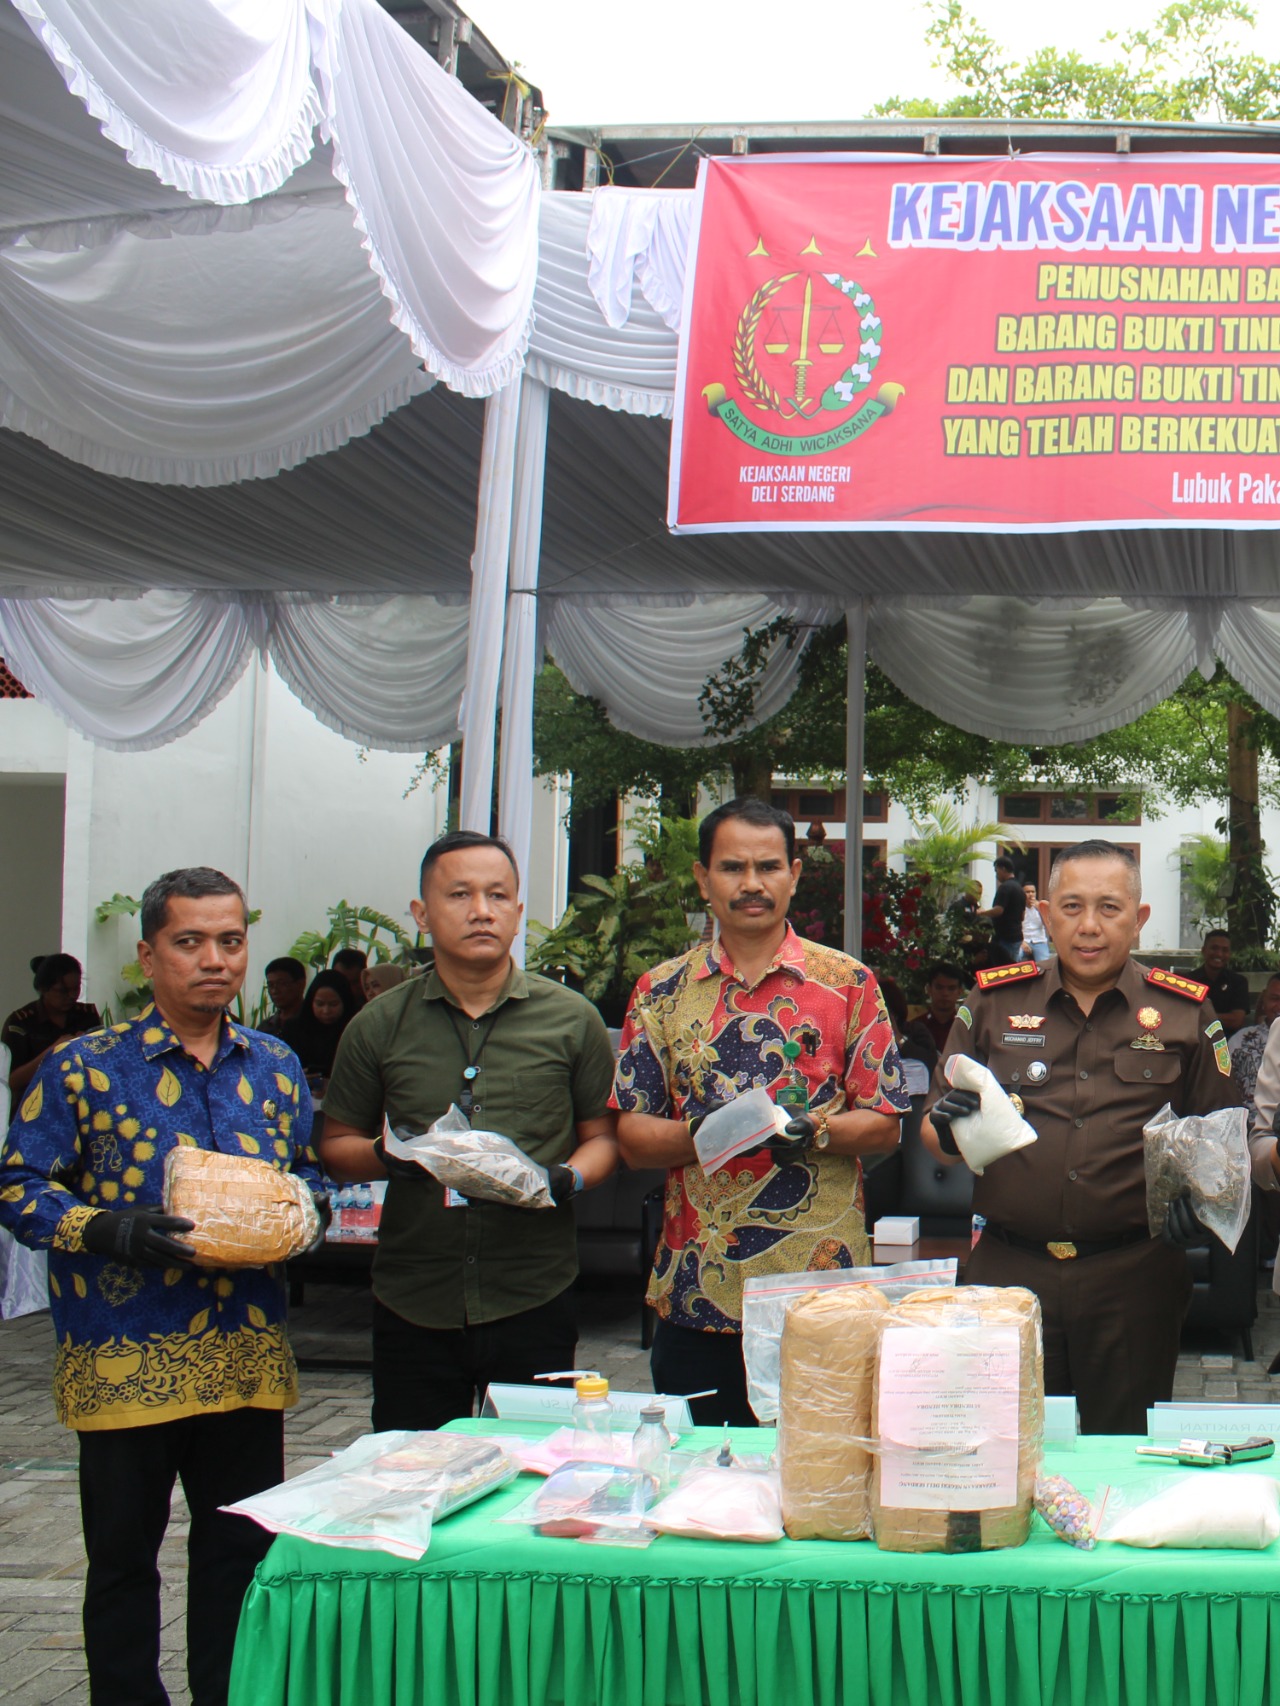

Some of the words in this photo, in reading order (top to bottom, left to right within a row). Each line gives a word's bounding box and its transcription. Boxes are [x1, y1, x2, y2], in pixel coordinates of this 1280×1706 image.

[888, 182, 1202, 252] KEJAKSAAN
[1036, 263, 1240, 303] PEMUSNAHAN
[996, 314, 1117, 353] BARANG
[1122, 316, 1215, 353] BUKTI
[947, 365, 1010, 404] DAN
[1014, 364, 1134, 404] BARANG
[1139, 366, 1235, 402] BUKTI
[722, 404, 758, 446] SATYA
[760, 434, 793, 453] ADHI
[799, 405, 878, 453] WICAKSANA
[942, 416, 1020, 457] YANG
[1026, 416, 1114, 456] TELAH
[739, 465, 805, 483] KEJAKSAAN
[807, 465, 851, 483] NEGERI
[751, 484, 778, 502] DELI
[780, 484, 835, 502] SERDANG
[1171, 472, 1231, 504] Lubuk
